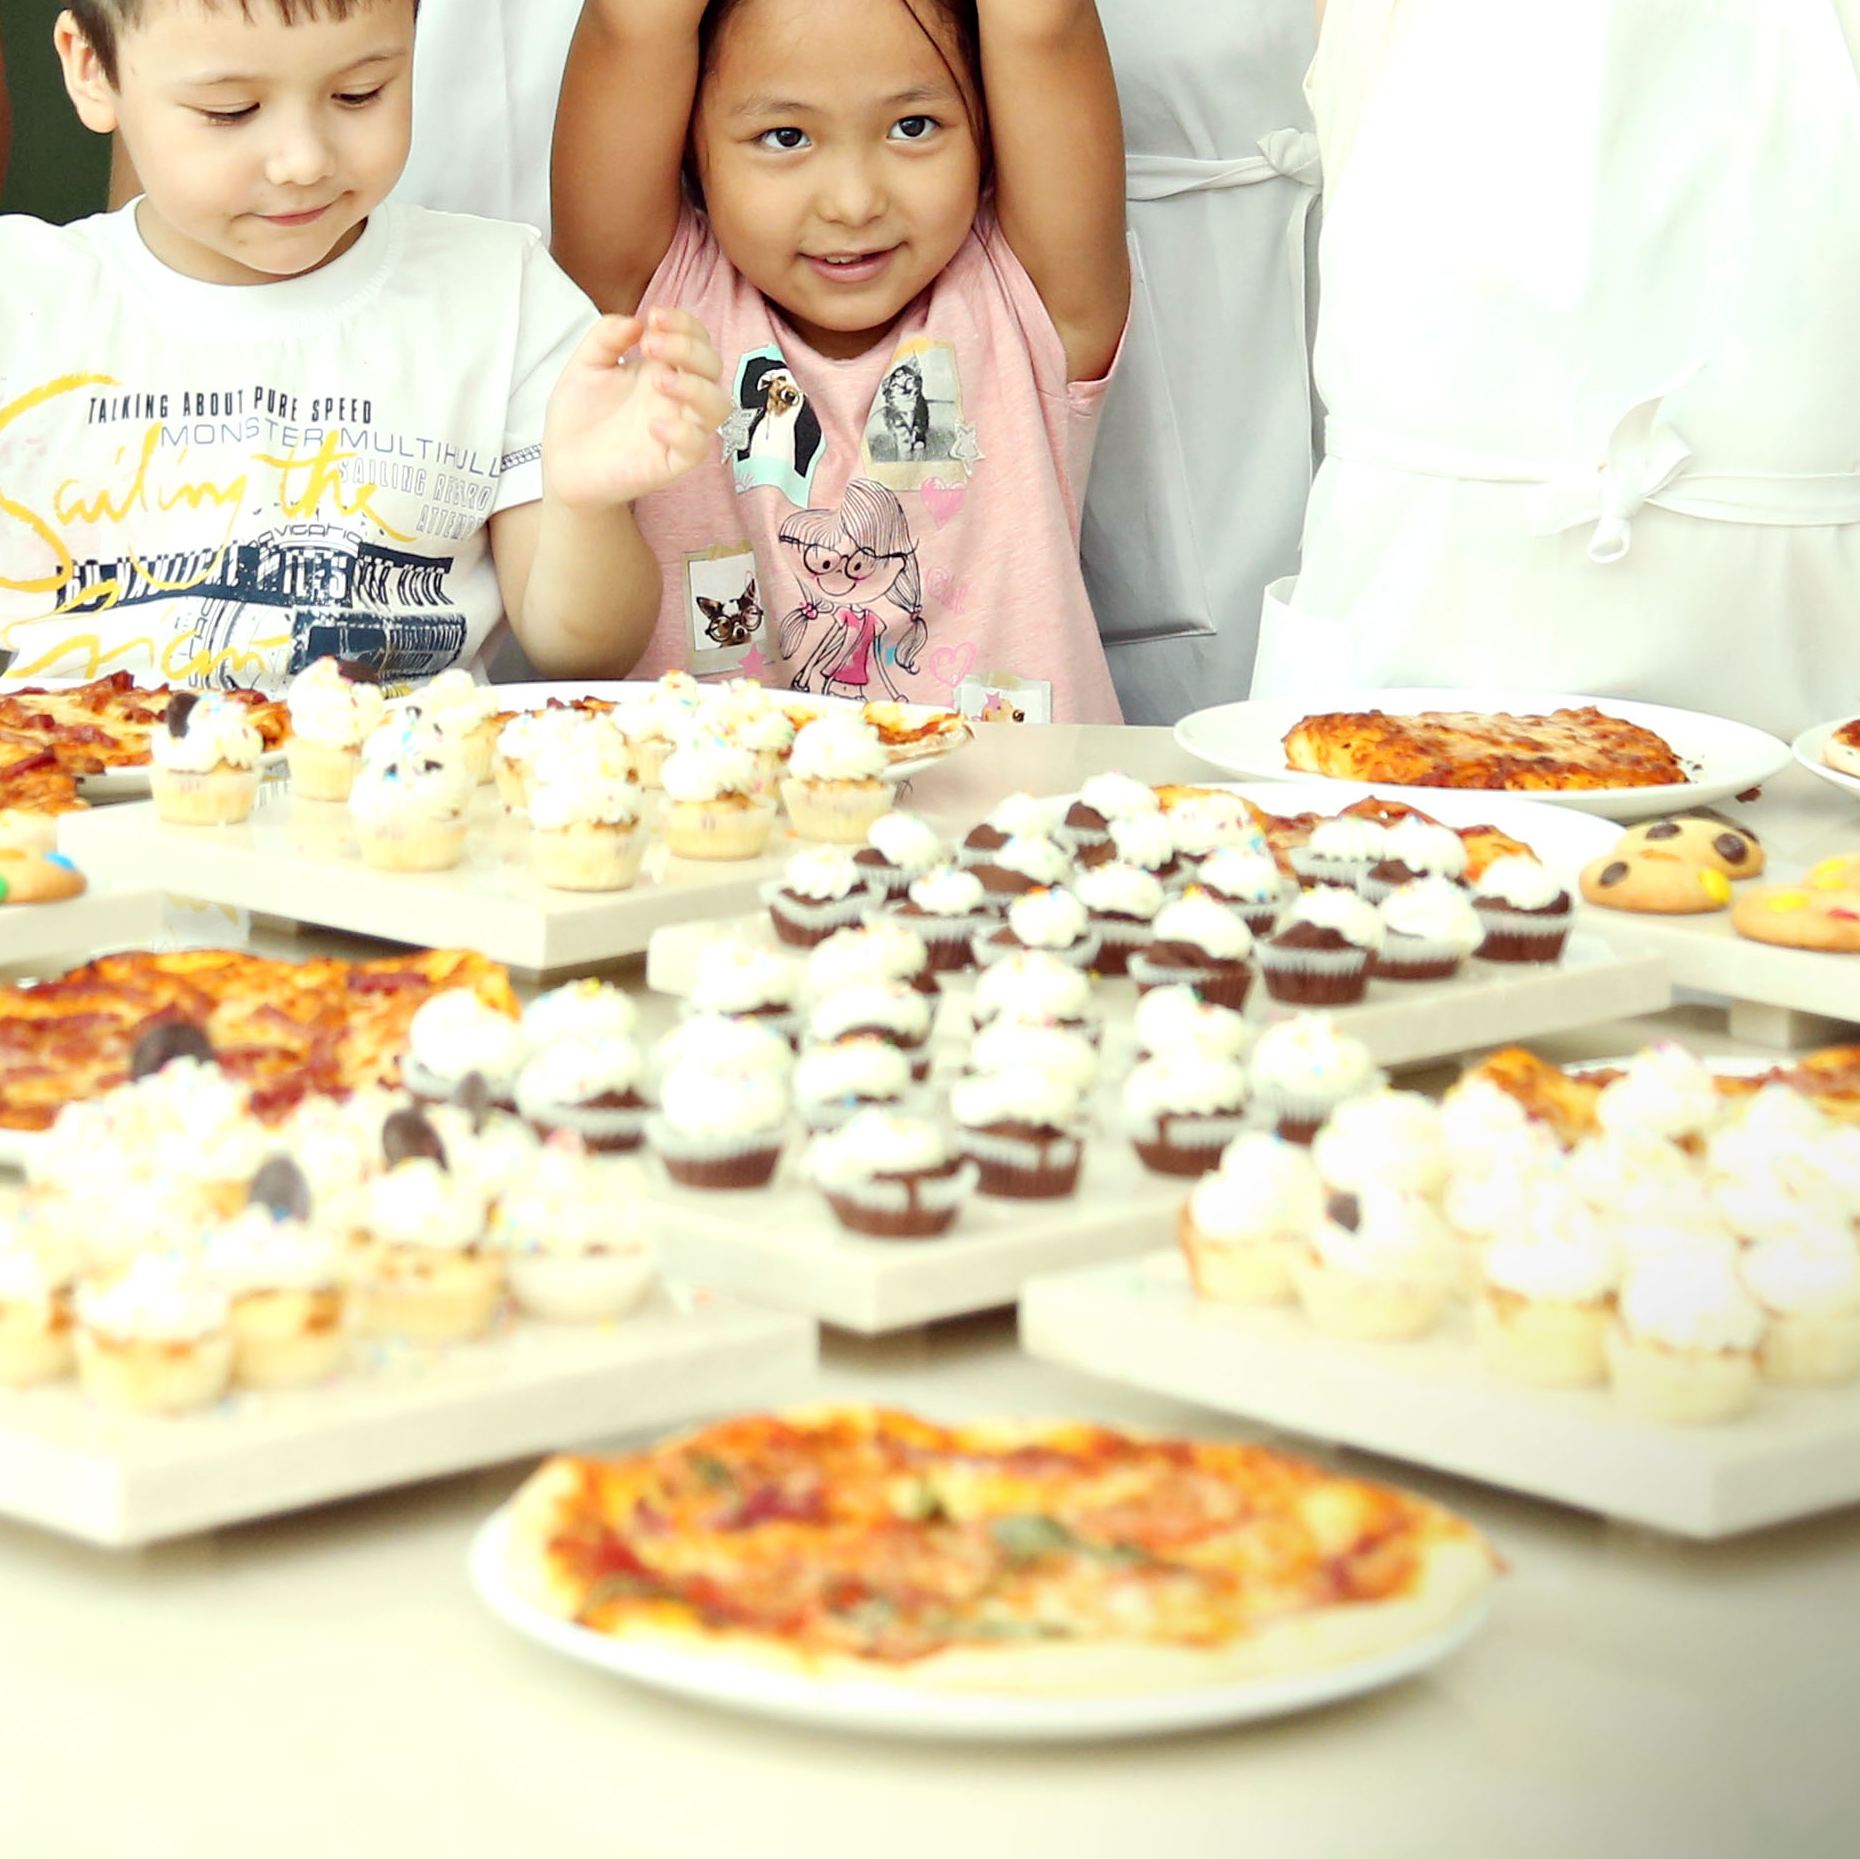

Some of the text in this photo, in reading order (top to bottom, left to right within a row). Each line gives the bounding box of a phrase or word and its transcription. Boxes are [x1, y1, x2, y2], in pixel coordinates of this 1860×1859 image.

[88, 385, 372, 425] TALKING ABOUT PURE SPEED
[161, 416, 324, 448] MONSTER
[249, 428, 418, 543] the
